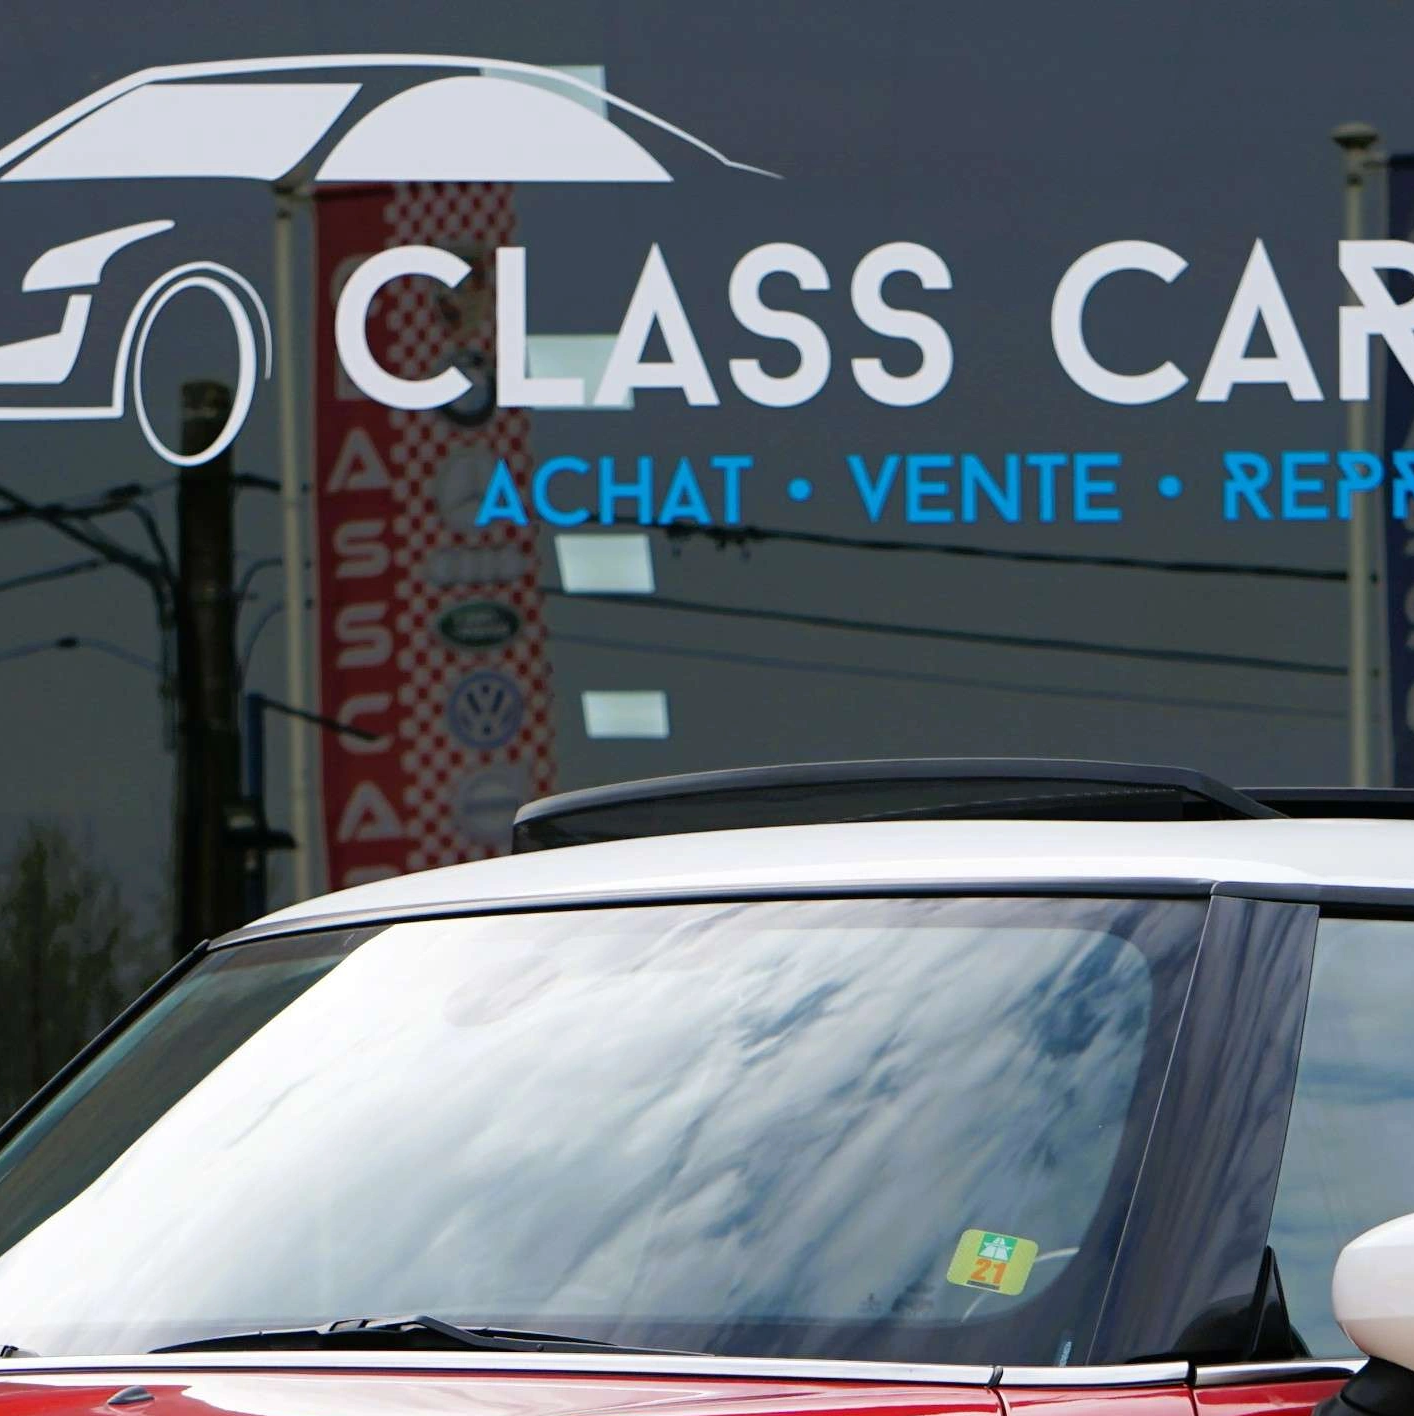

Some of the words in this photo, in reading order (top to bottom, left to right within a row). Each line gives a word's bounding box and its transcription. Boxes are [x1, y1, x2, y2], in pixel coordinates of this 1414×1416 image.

[334, 241, 955, 411] CLASS
[475, 454, 754, 526] ACHAT
[847, 453, 1123, 524] VENTE
[970, 1258, 1008, 1284] 21
